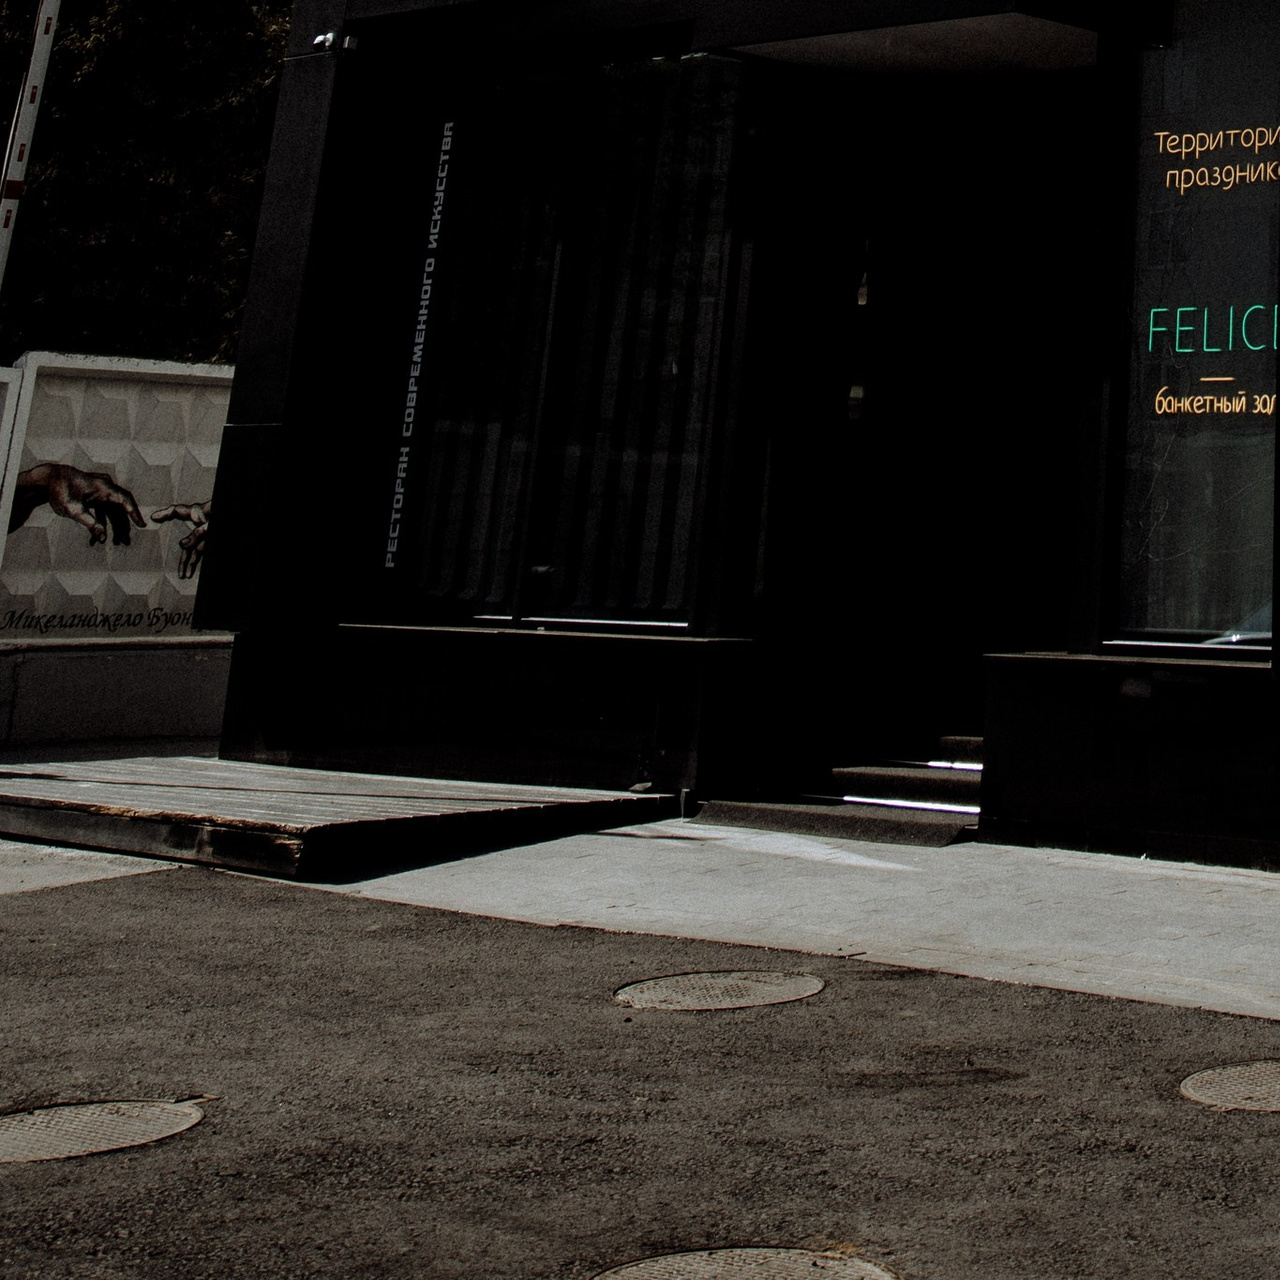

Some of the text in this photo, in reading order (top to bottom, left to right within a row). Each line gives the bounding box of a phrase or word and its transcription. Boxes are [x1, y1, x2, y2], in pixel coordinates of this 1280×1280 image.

[384, 121, 454, 569] РЕСТОРАН СОВРЕМЕННОГО ИСКУССТВА
[1154, 386, 1247, 415] банкетный
[0, 606, 144, 634] Микеланджело
